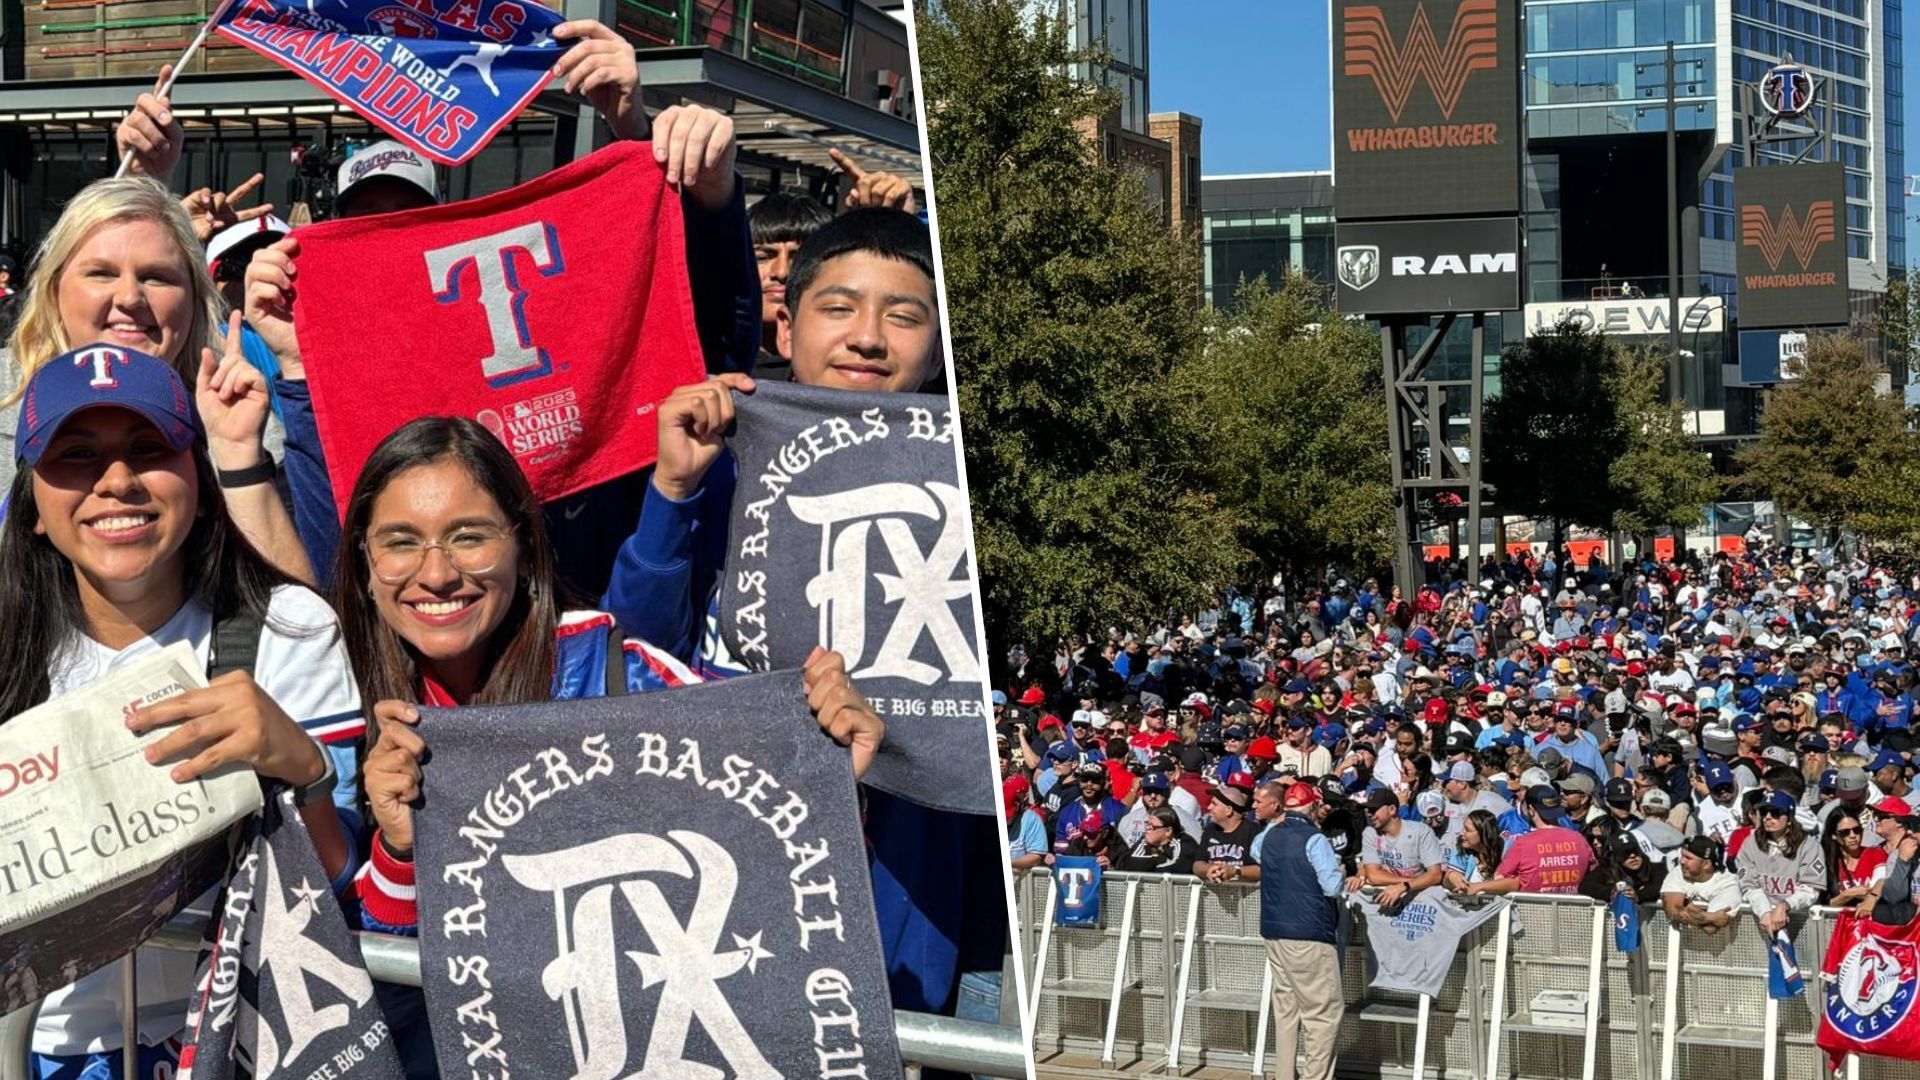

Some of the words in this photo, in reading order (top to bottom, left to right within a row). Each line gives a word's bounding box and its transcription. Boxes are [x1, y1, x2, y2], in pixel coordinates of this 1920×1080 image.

[231, 0, 480, 152] CHAMPIONS
[389, 43, 461, 102] WORLD
[1768, 69, 1806, 115] T
[1347, 122, 1498, 152] WHATABURGER
[348, 149, 422, 182] Rangers
[1391, 252, 1517, 277] RAM
[1745, 271, 1836, 289] WHATABURGER
[424, 220, 566, 388] T
[1535, 302, 1713, 333] LOEWS
[74, 347, 130, 390] T
[532, 390, 576, 411] 2023
[506, 404, 581, 437] WORLD
[511, 421, 583, 454] SERIES
[740, 407, 890, 560] RANGERS
[890, 698, 926, 716] BIG
[1207, 843, 1244, 859] TEXAS
[1537, 843, 1553, 854] DO
[1555, 841, 1577, 853] NOT
[1540, 854, 1579, 867] ARREST
[1059, 868, 1094, 908] T
[1540, 869, 1580, 884] THIS
[443, 732, 615, 940] RANGERS
[635, 732, 846, 952] BASEBALL
[805, 967, 870, 1080] CLU
[1406, 903, 1438, 915] ORLD
[1829, 988, 1908, 1034] ANGERS
[332, 1042, 365, 1074] BIG
